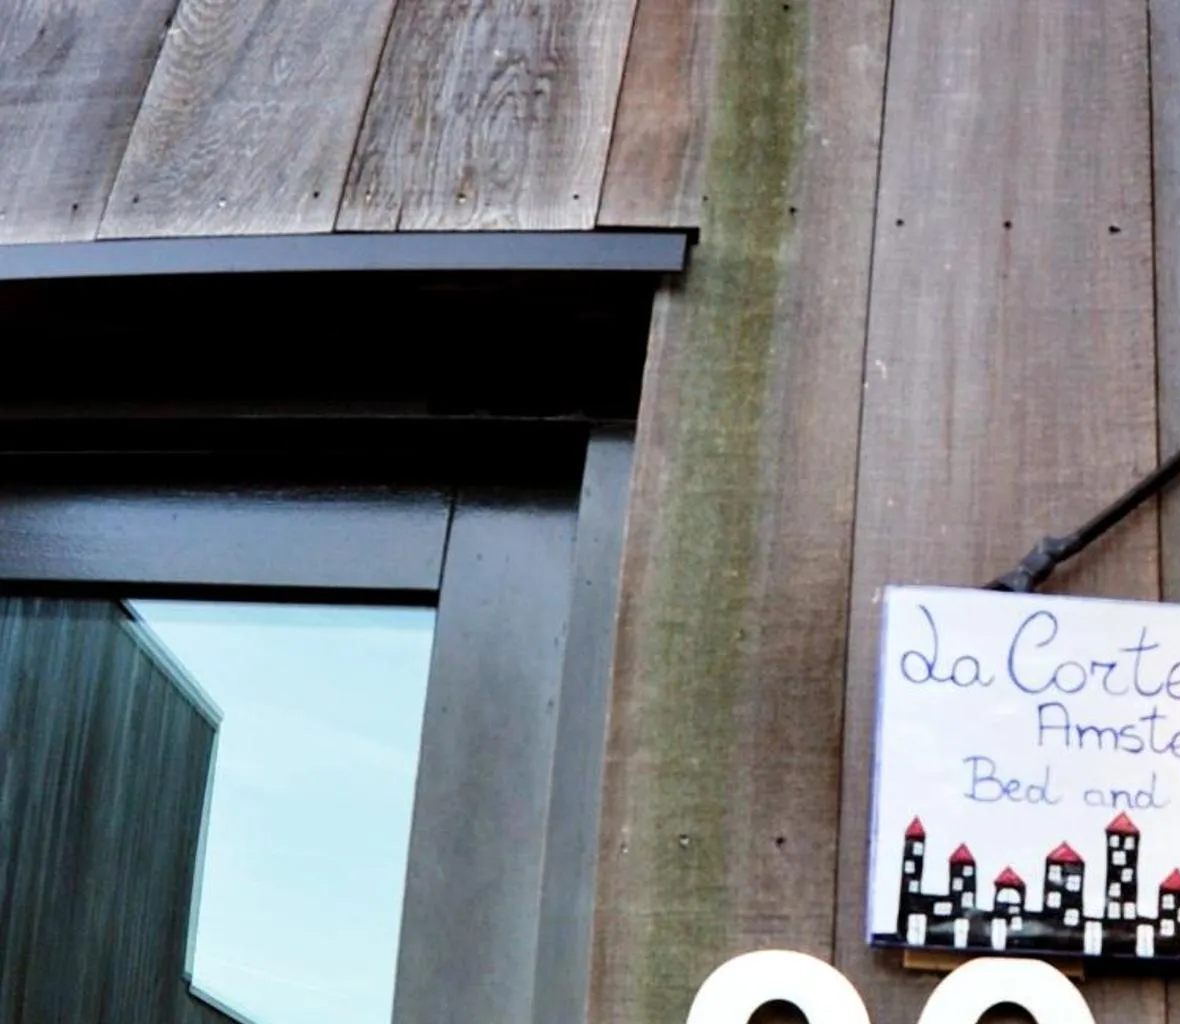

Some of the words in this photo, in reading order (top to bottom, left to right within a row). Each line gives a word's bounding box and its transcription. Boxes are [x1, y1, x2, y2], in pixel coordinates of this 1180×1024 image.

[900, 604, 995, 688] La
[963, 755, 1052, 805] Bed
[1083, 772, 1166, 810] and
